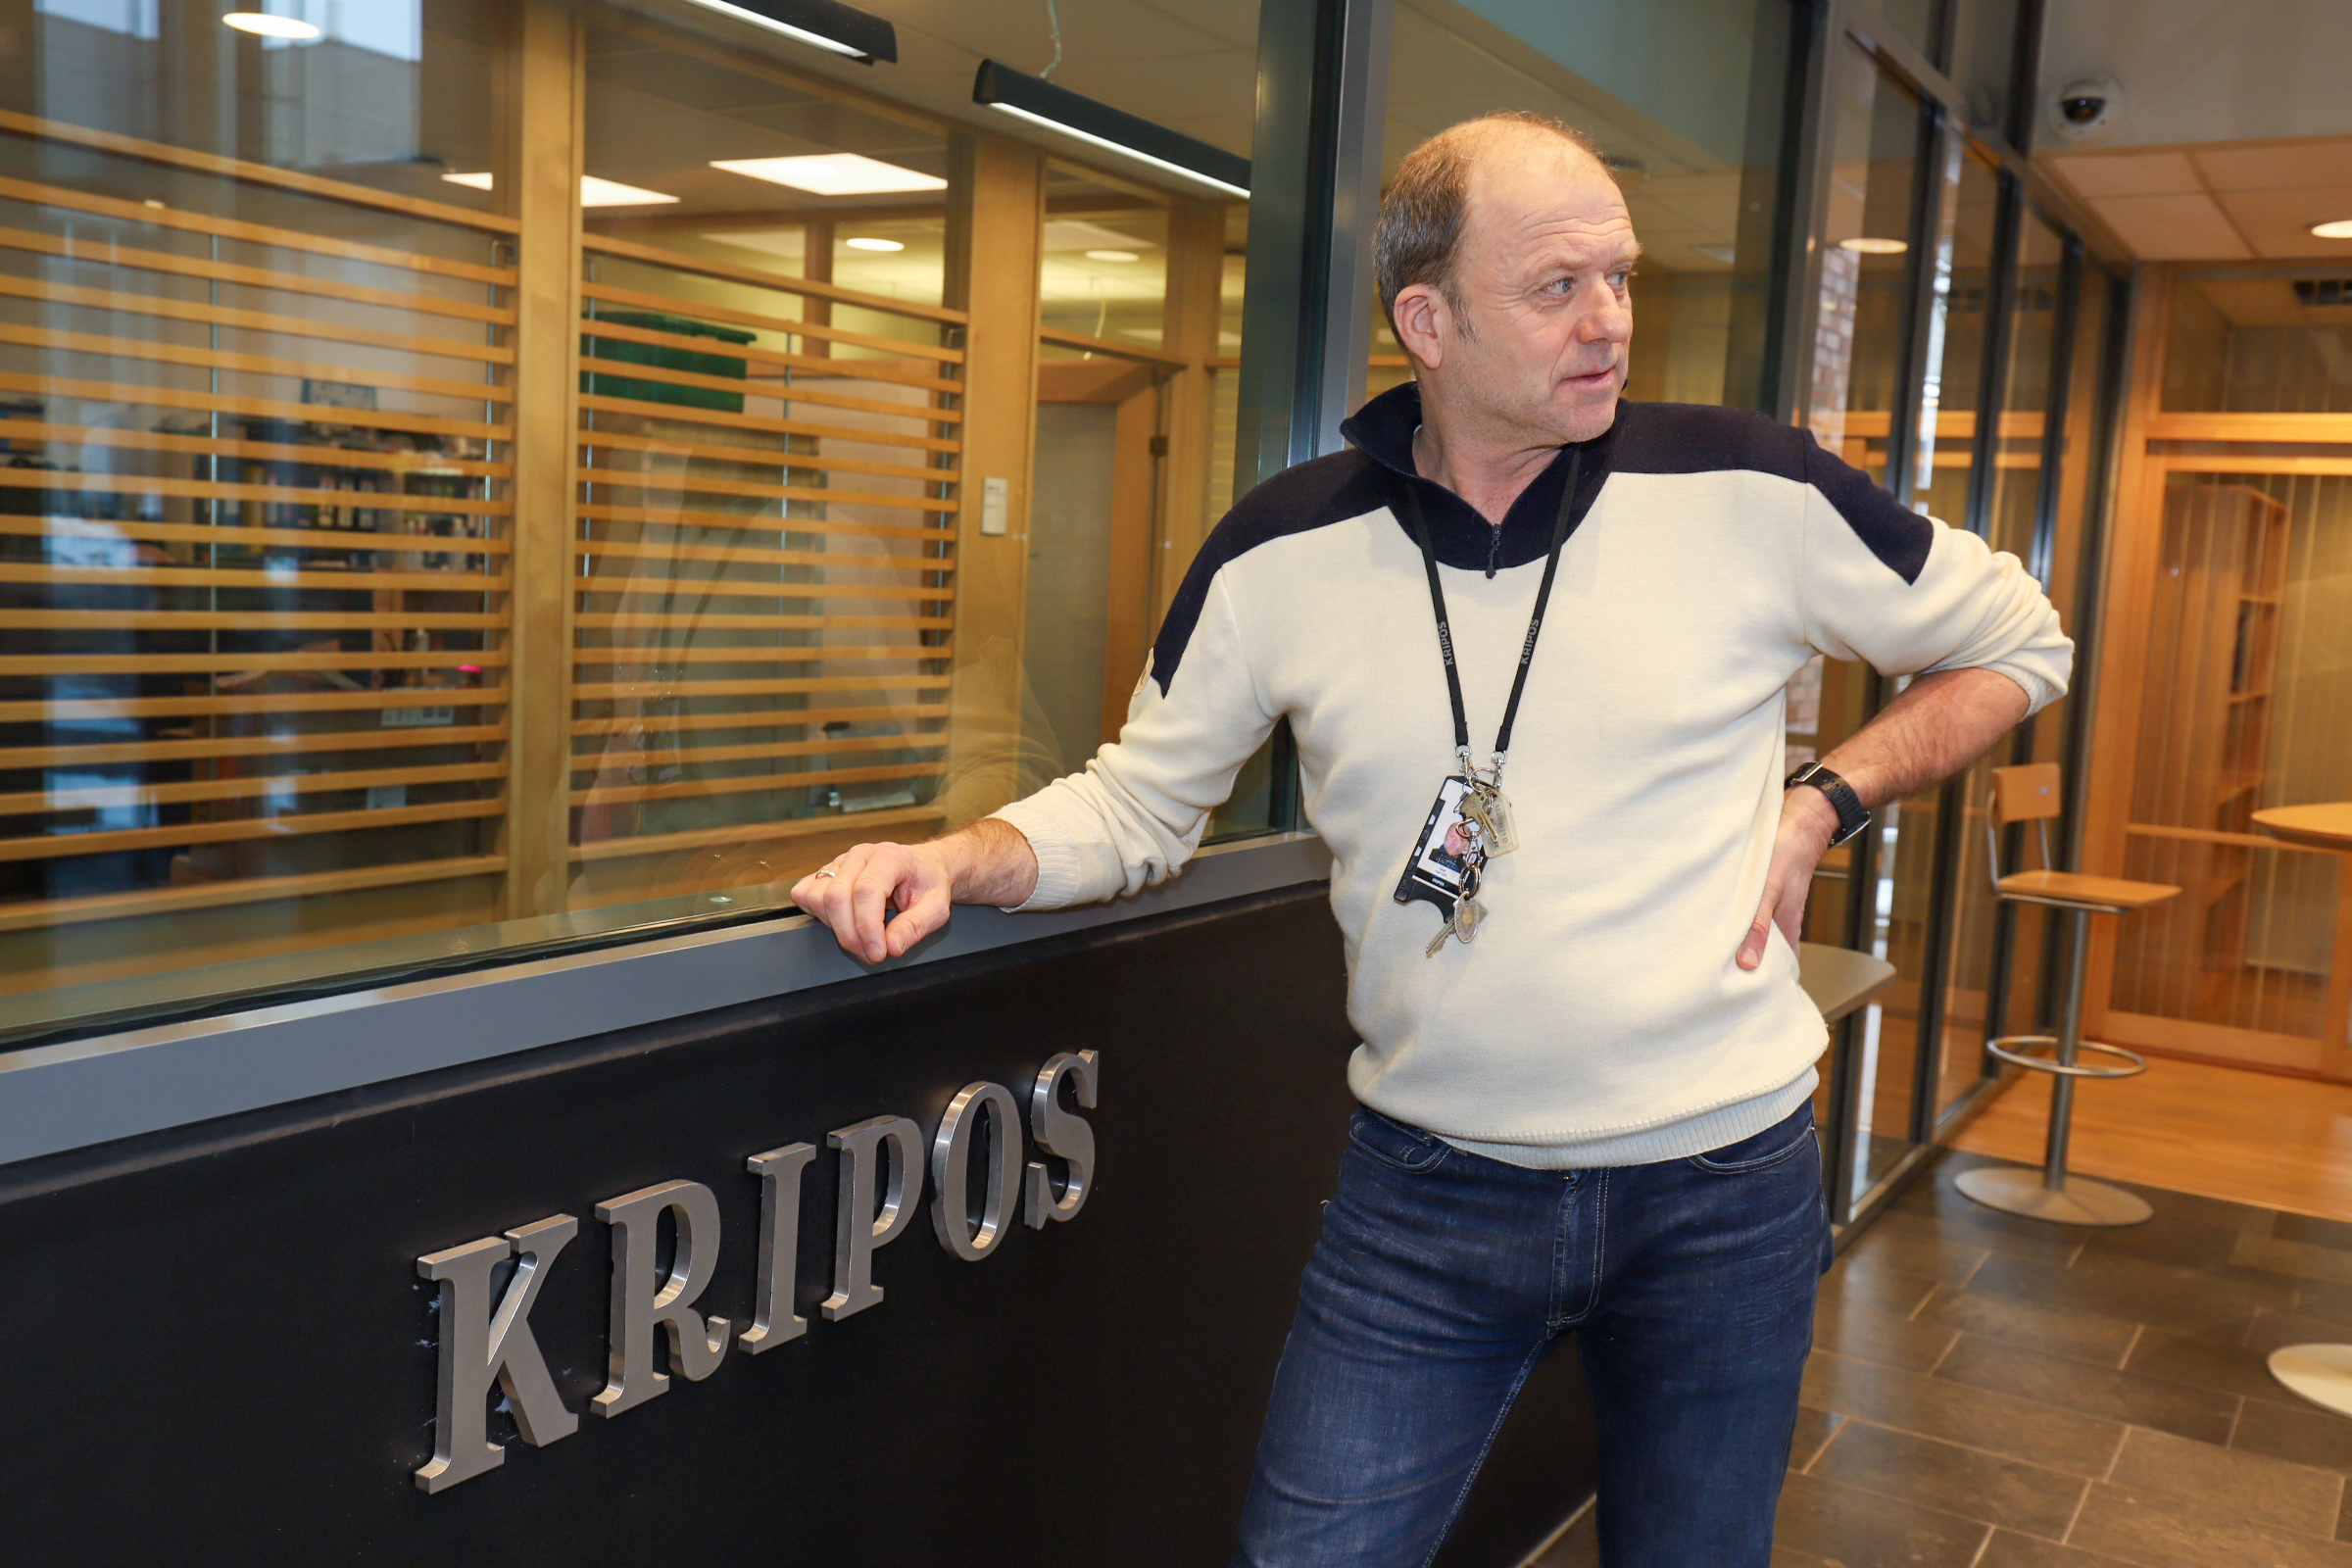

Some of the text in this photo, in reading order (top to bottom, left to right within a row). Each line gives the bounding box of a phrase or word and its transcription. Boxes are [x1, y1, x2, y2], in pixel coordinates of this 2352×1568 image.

[1438, 620, 1453, 665] KRIPOS
[1521, 618, 1540, 664] KRIPOS
[416, 1050, 1099, 1494] KRIPOS
